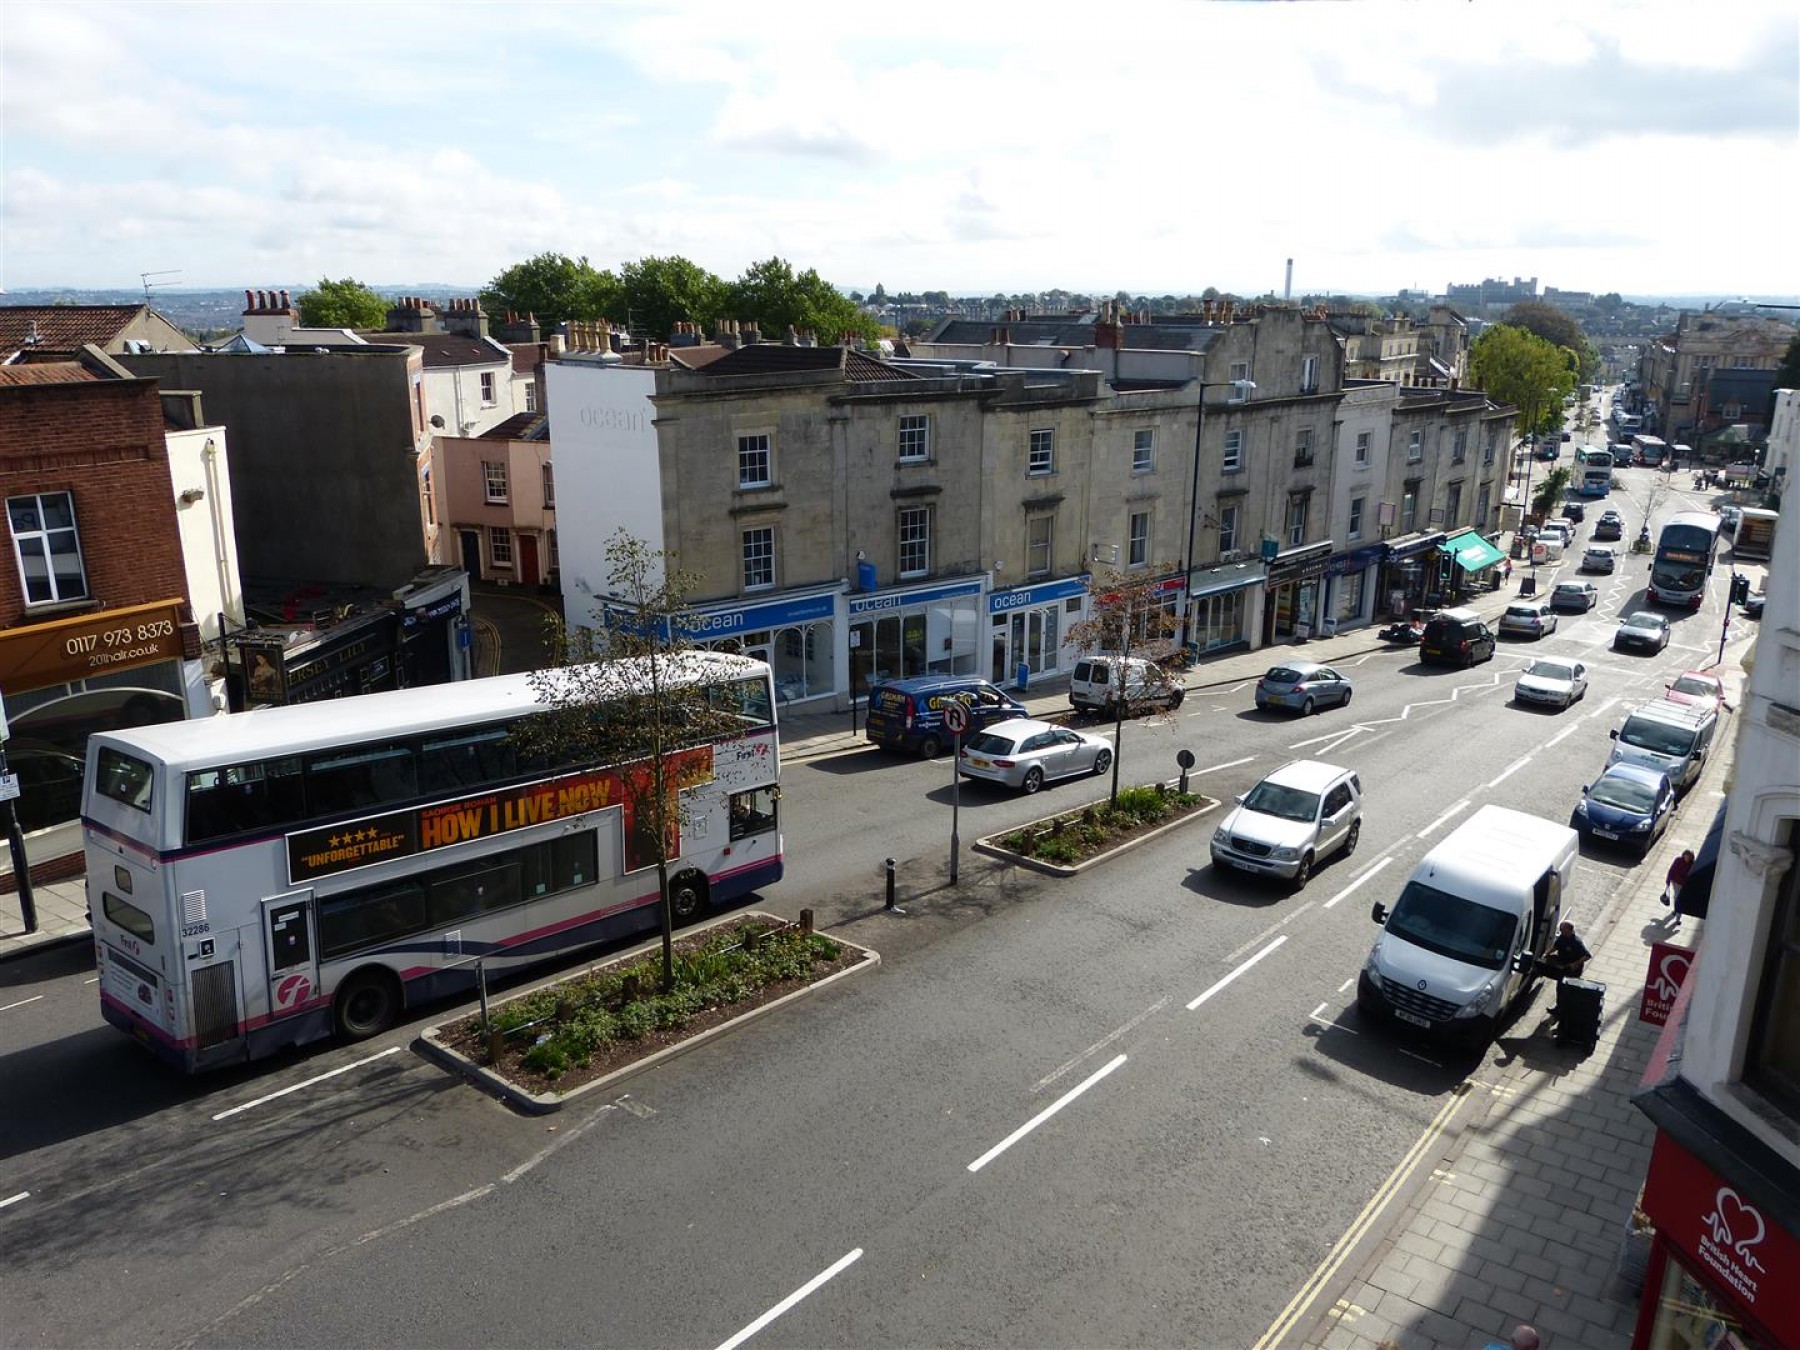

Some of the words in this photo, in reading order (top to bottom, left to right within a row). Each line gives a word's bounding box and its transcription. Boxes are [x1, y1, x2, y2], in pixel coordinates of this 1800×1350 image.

[580, 405, 646, 432] ocean
[855, 595, 901, 612] ocean
[994, 590, 1031, 609] ocean
[689, 612, 744, 633] ocean
[66, 634, 97, 655] 0117
[103, 628, 132, 647] 973
[137, 619, 174, 641] 8373
[287, 659, 331, 687] ERSEY
[422, 808, 483, 850] HOW
[489, 803, 499, 833] I
[504, 791, 555, 829] LIVE
[558, 779, 612, 817] NOW
[182, 923, 210, 938] 32286
[1698, 1243, 1756, 1303] Foundation
[1700, 1234, 1730, 1266] British
[1730, 1261, 1758, 1292] Heart
